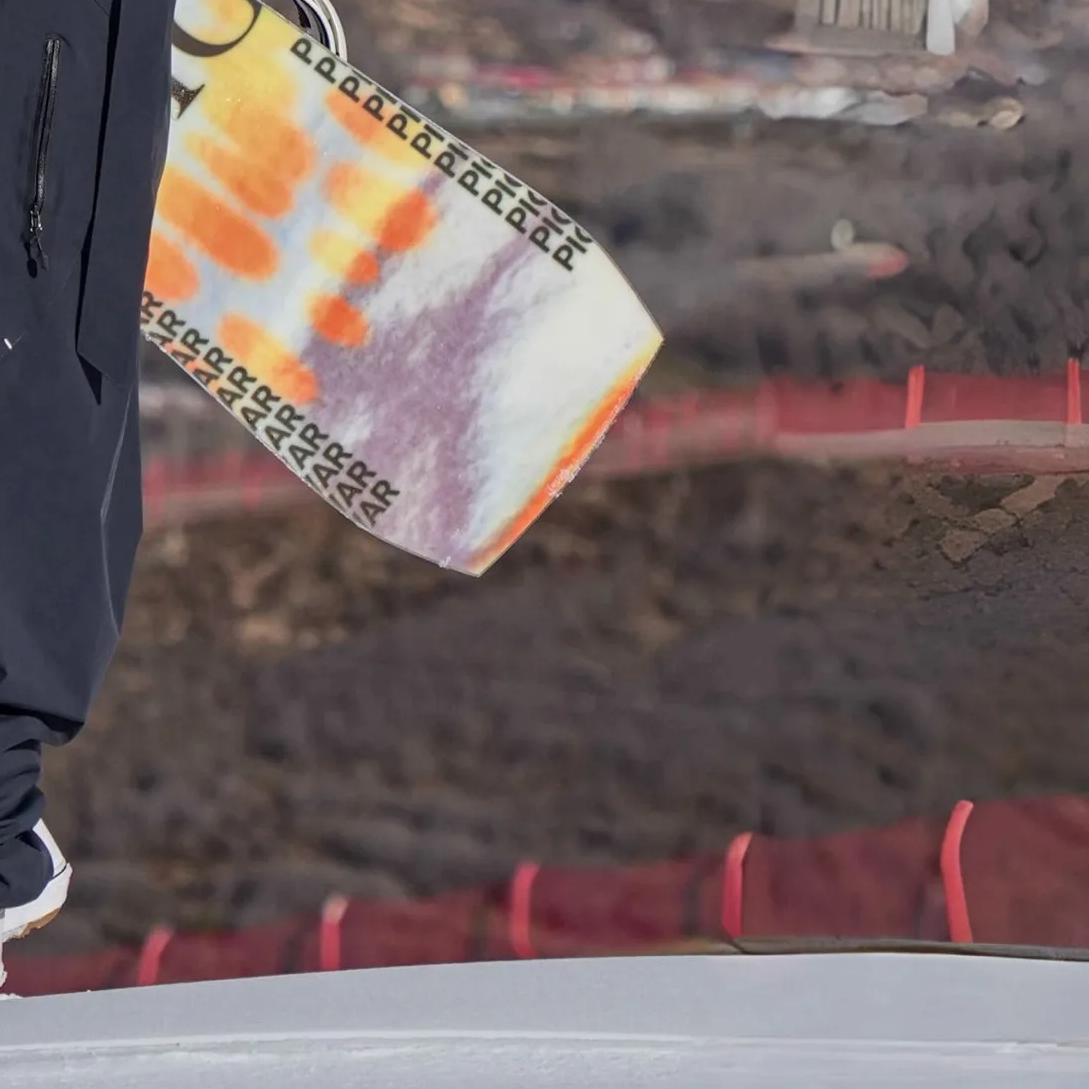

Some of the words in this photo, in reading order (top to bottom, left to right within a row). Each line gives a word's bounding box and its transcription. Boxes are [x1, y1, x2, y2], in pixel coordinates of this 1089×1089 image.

[386, 105, 421, 141] PI
[410, 124, 445, 159] PI
[434, 141, 471, 178] PI
[457, 158, 497, 197] PI
[217, 366, 257, 407] AR
[240, 385, 281, 430] AR
[265, 404, 305, 451] AR
[288, 422, 329, 470] AR
[306, 442, 353, 491] AR
[330, 461, 377, 510] AR
[353, 480, 400, 527] AR
